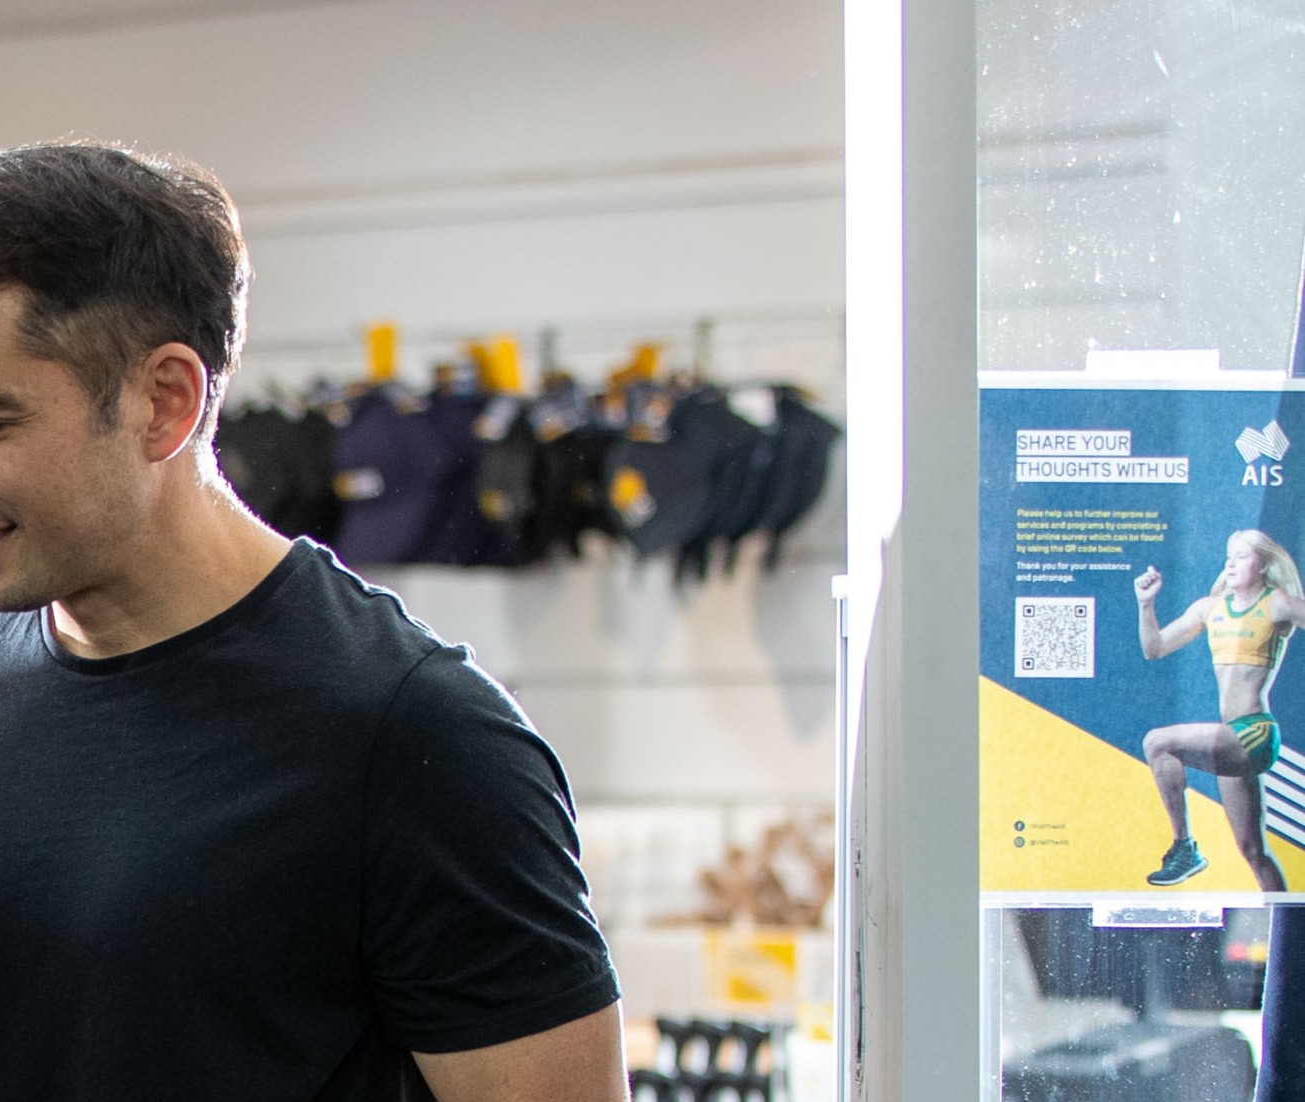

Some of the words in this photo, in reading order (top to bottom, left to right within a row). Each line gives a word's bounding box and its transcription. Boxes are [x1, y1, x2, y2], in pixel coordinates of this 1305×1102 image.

[1017, 435, 1076, 451] SHARE
[1081, 435, 1129, 451] YOUR
[1017, 462, 1111, 477] THOUGHTS
[1117, 462, 1158, 478] WITH
[1164, 463, 1187, 478] US
[1241, 465, 1284, 486] AIS
[1016, 562, 1041, 570] Thank
[1042, 563, 1057, 571] you
[1057, 562, 1069, 570] for
[1070, 563, 1087, 571] your
[1089, 563, 1131, 571] assistance
[1016, 574, 1031, 582] and
